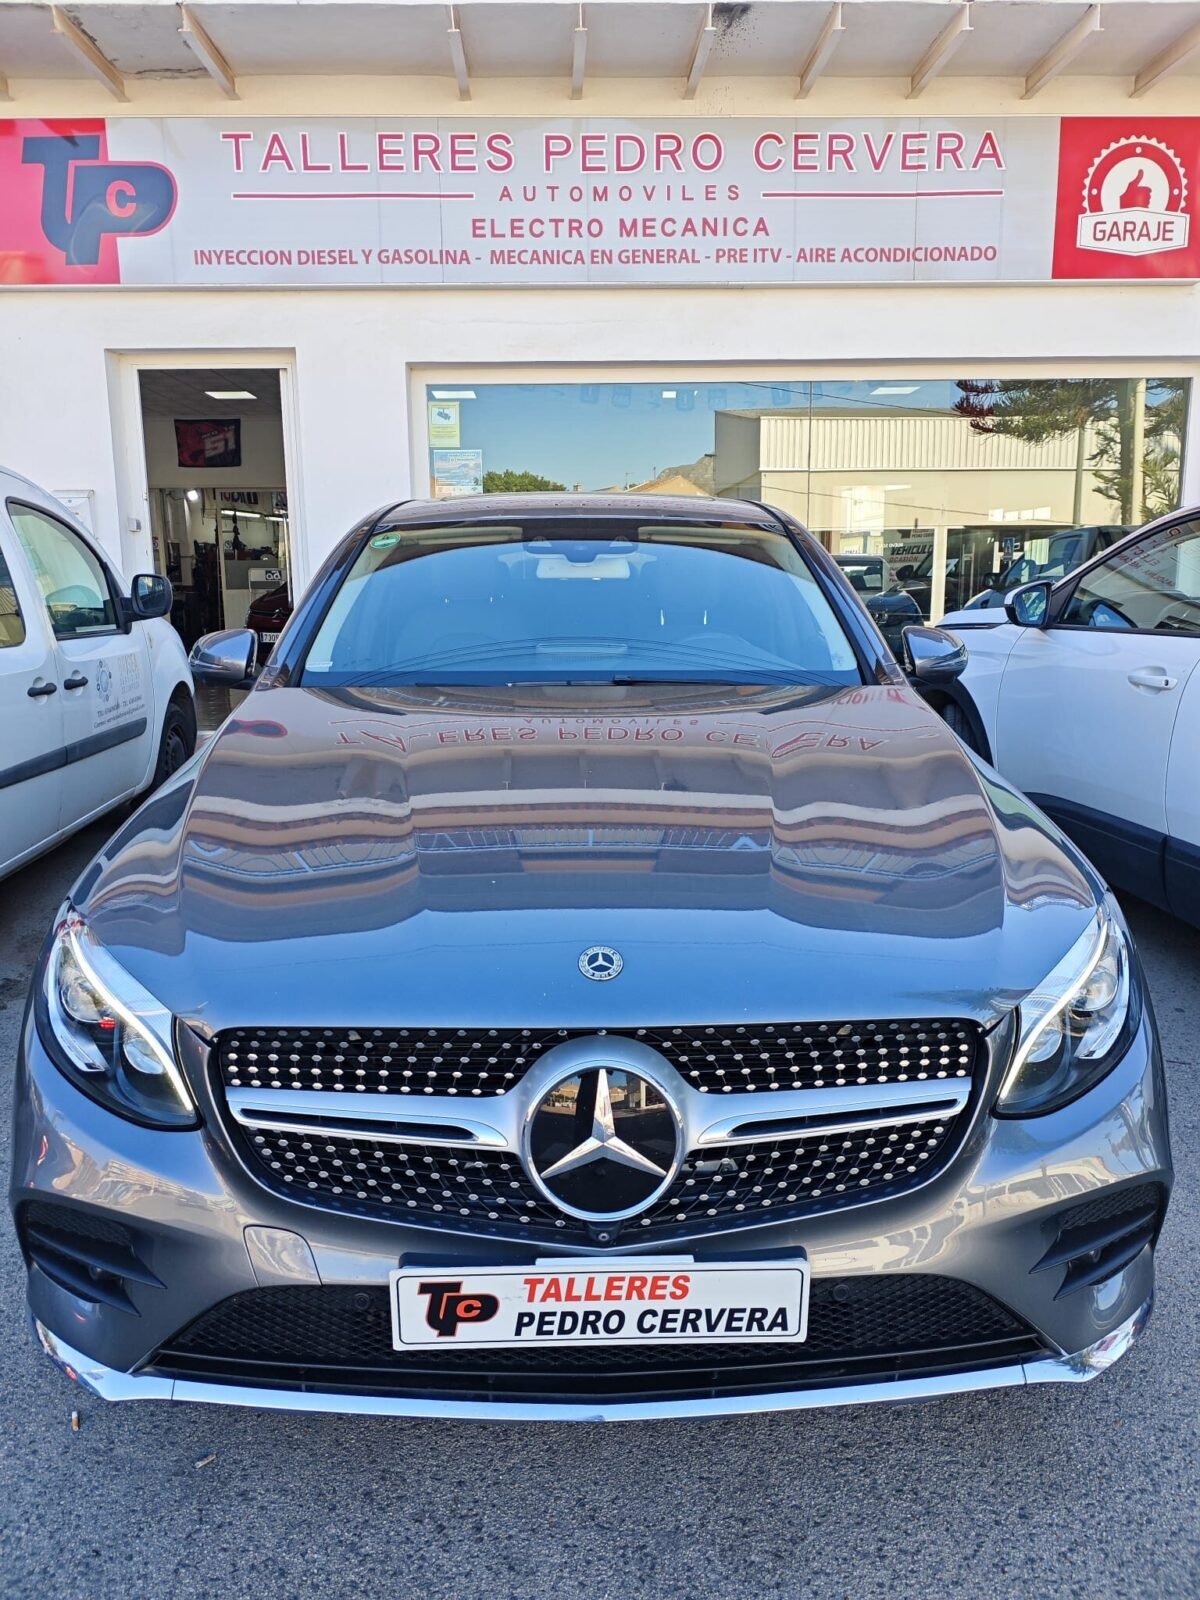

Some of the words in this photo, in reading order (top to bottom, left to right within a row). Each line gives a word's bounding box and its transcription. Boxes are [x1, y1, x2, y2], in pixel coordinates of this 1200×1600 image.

[221, 132, 514, 173] TALLERES
[544, 132, 724, 173] PEDRO
[753, 131, 1005, 172] CERVERA
[499, 185, 740, 202] AUTOMOVILES
[471, 217, 604, 239] ELECTRO
[619, 216, 769, 238] MECANICA
[1092, 221, 1174, 242] GARAJE
[194, 250, 292, 265] INYECCION
[297, 250, 358, 265] DIESEL
[363, 249, 372, 264] Y
[377, 249, 471, 265] GASOLINA
[490, 249, 585, 265] MECANICA
[590, 249, 614, 265] EN
[618, 249, 700, 265] GENERAL
[715, 248, 748, 264] PRE
[753, 247, 782, 263] ITV
[797, 248, 836, 263] AIRE
[840, 246, 997, 263] ACONDICIONADO
[523, 1275, 691, 1303] TALLERES
[514, 1309, 626, 1337] PEDRO
[636, 1307, 789, 1335] CERVERA
